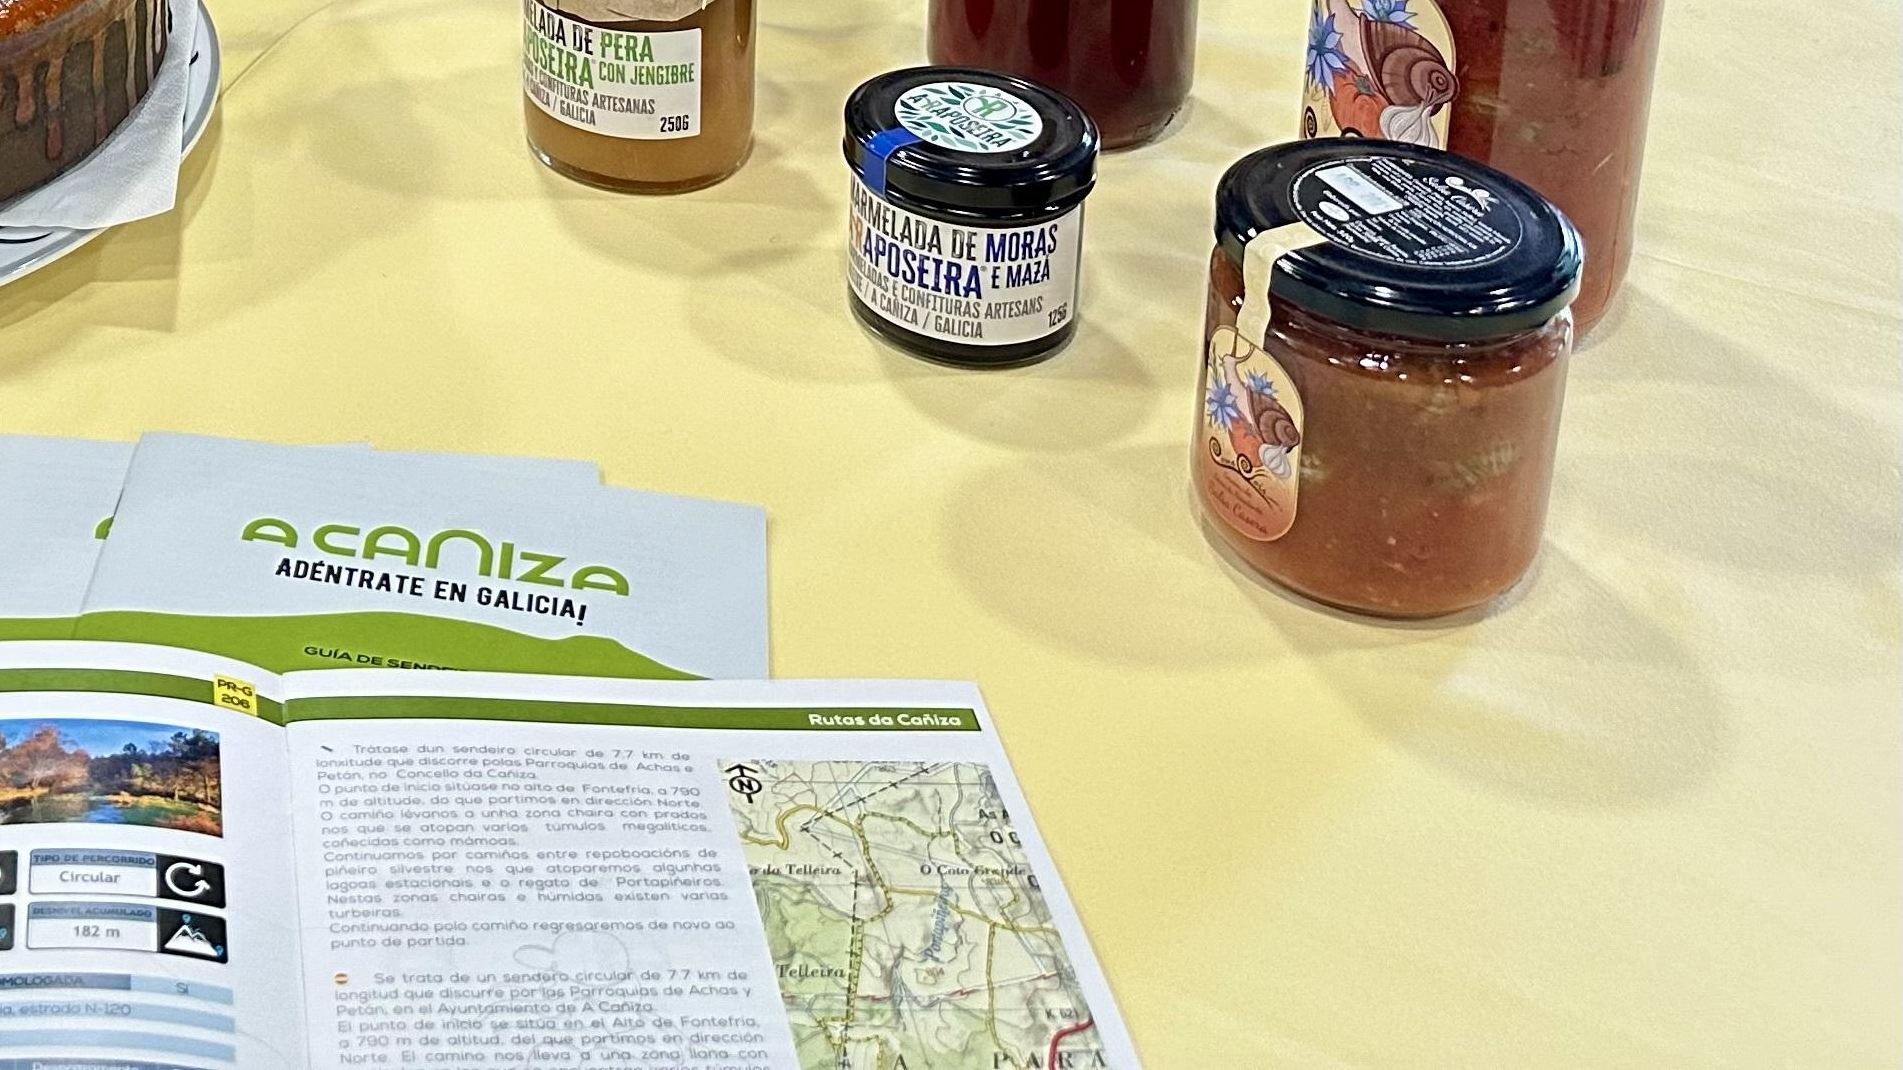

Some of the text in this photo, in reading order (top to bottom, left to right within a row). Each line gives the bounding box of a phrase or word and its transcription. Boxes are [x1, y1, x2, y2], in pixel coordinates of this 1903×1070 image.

[572, 23, 594, 56] DE
[600, 31, 654, 63] PERA
[524, 22, 696, 90] POSEIRA CON JENGIBRE
[592, 92, 656, 116] ARTESANAS
[559, 100, 596, 126] GALICIA
[660, 114, 690, 133] 250G
[951, 228, 977, 261] DE
[985, 223, 1058, 263] MORAS
[991, 266, 1000, 289] E
[901, 283, 1043, 321] CONFITURAS ARTESANS
[871, 289, 984, 339] A CAÑIZA GALICIA
[1048, 302, 1068, 328] 125G
[241, 517, 299, 549] A
[274, 557, 588, 627] ADÉNTRATE EN GALICIA!
[304, 645, 384, 667] GUÍA DE
[218, 679, 253, 696] PR-G
[222, 694, 251, 709] 206
[808, 713, 962, 726] Rutas da Cañiza
[354, 744, 577, 757] Trátase dun sendeiro circular
[419, 756, 477, 767] discorre
[483, 758, 522, 769] polas
[525, 758, 606, 771] Parroquias
[396, 769, 459, 779] Concello
[335, 784, 700, 797] punto 790
[489, 795, 652, 807] partimos dirección
[654, 810, 708, 821] prados
[33, 854, 155, 866] TIPO DE PERCORRIDO
[536, 850, 578, 860] entre
[59, 870, 121, 883] Circular
[325, 864, 454, 877] piñeiro silvestre
[327, 892, 670, 905] Nestas chairas existen
[73, 926, 120, 939] 182 m
[329, 920, 644, 934] Continuando regresaremos
[19, 1002, 82, 1017] estrada
[86, 1003, 132, 1017] N-120
[438, 1002, 551, 1016] Ayuntamiento
